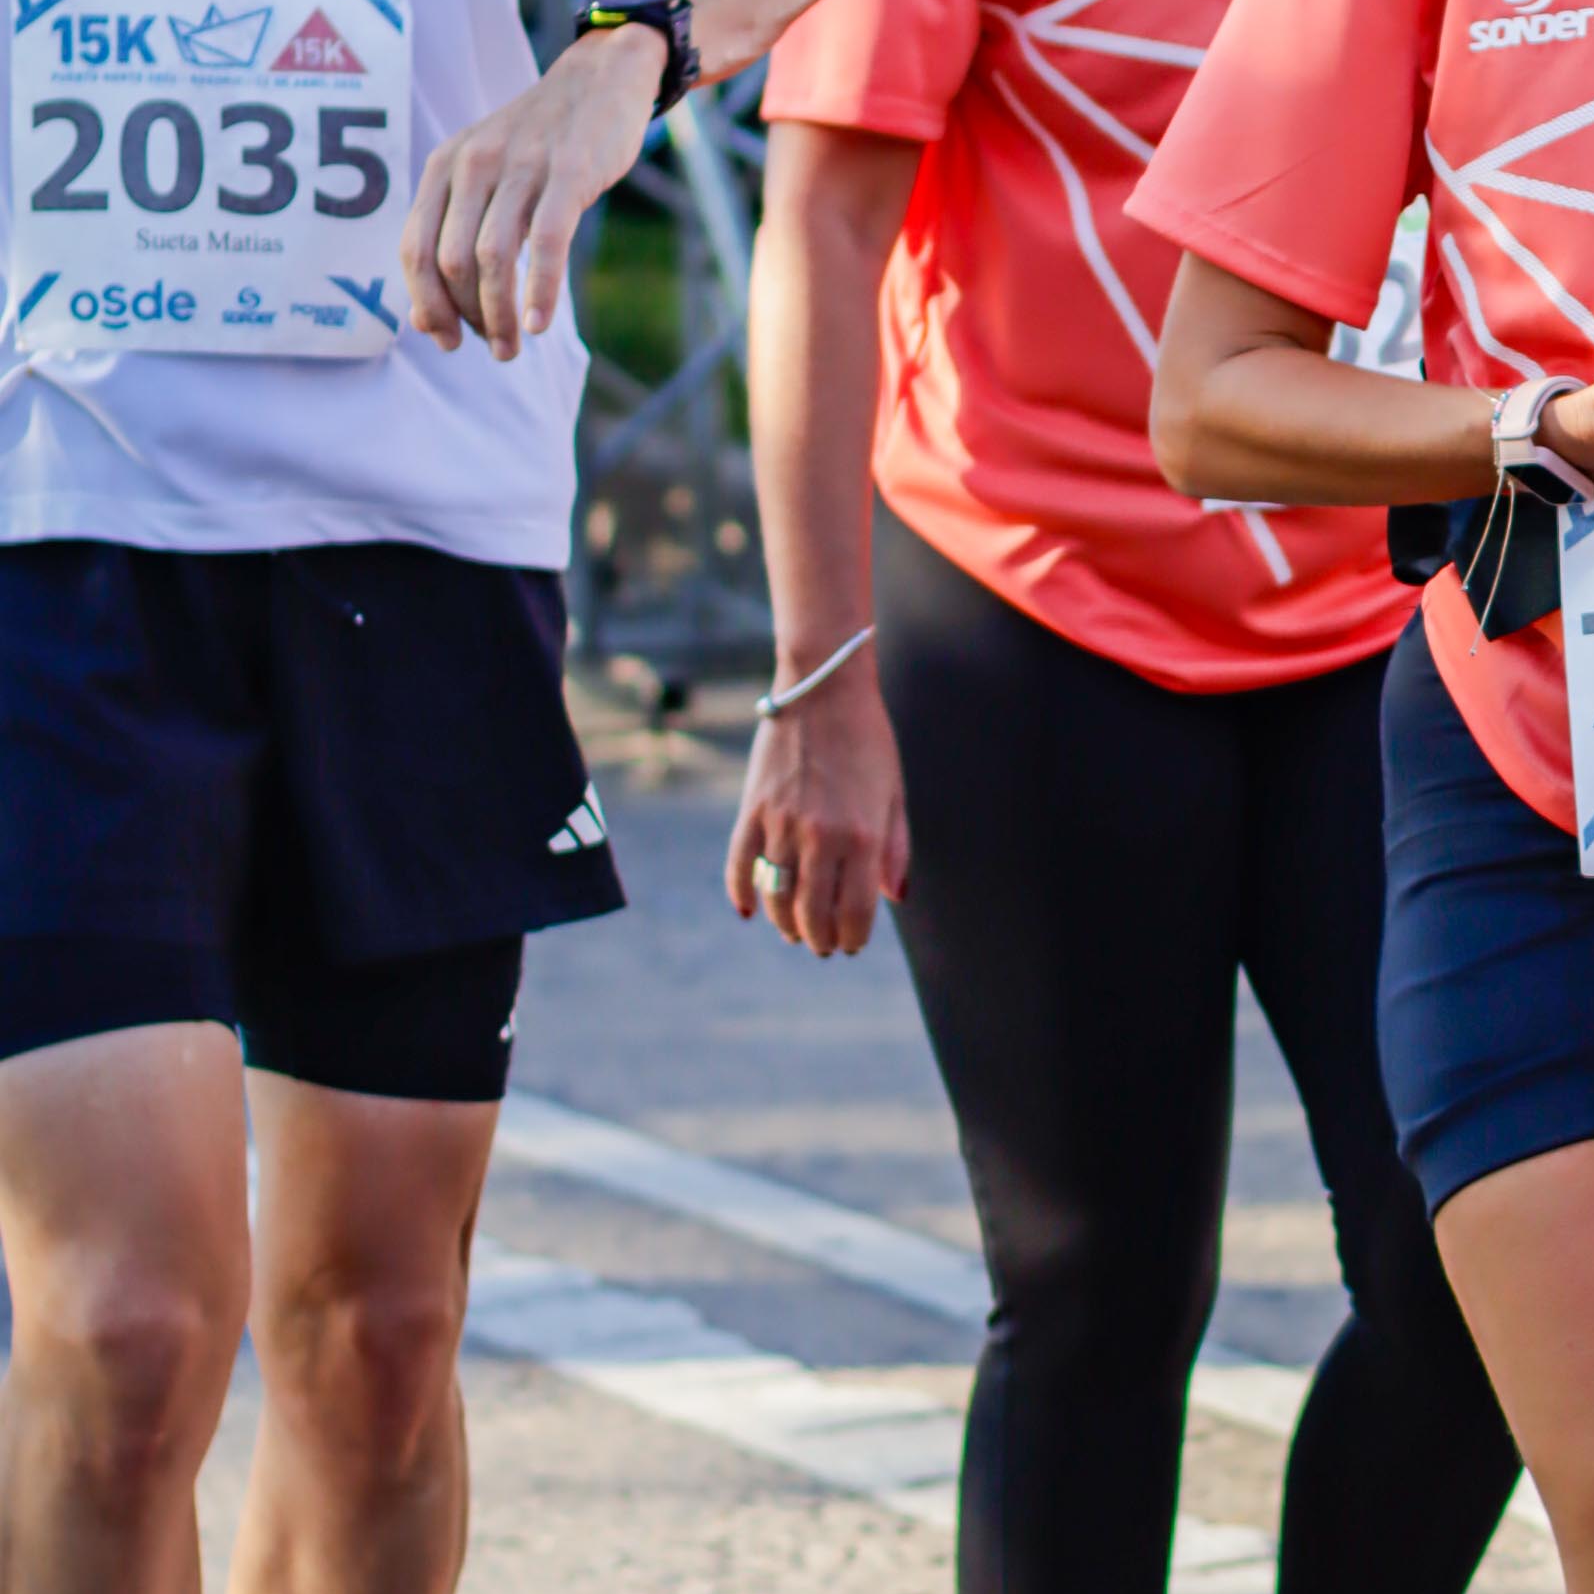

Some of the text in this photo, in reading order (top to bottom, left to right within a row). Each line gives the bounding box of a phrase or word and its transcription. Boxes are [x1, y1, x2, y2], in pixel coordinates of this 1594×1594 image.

[52, 14, 156, 65] 15K
[31, 98, 390, 219] 2035
[208, 229, 284, 254] Matias
[70, 279, 197, 329] osde
